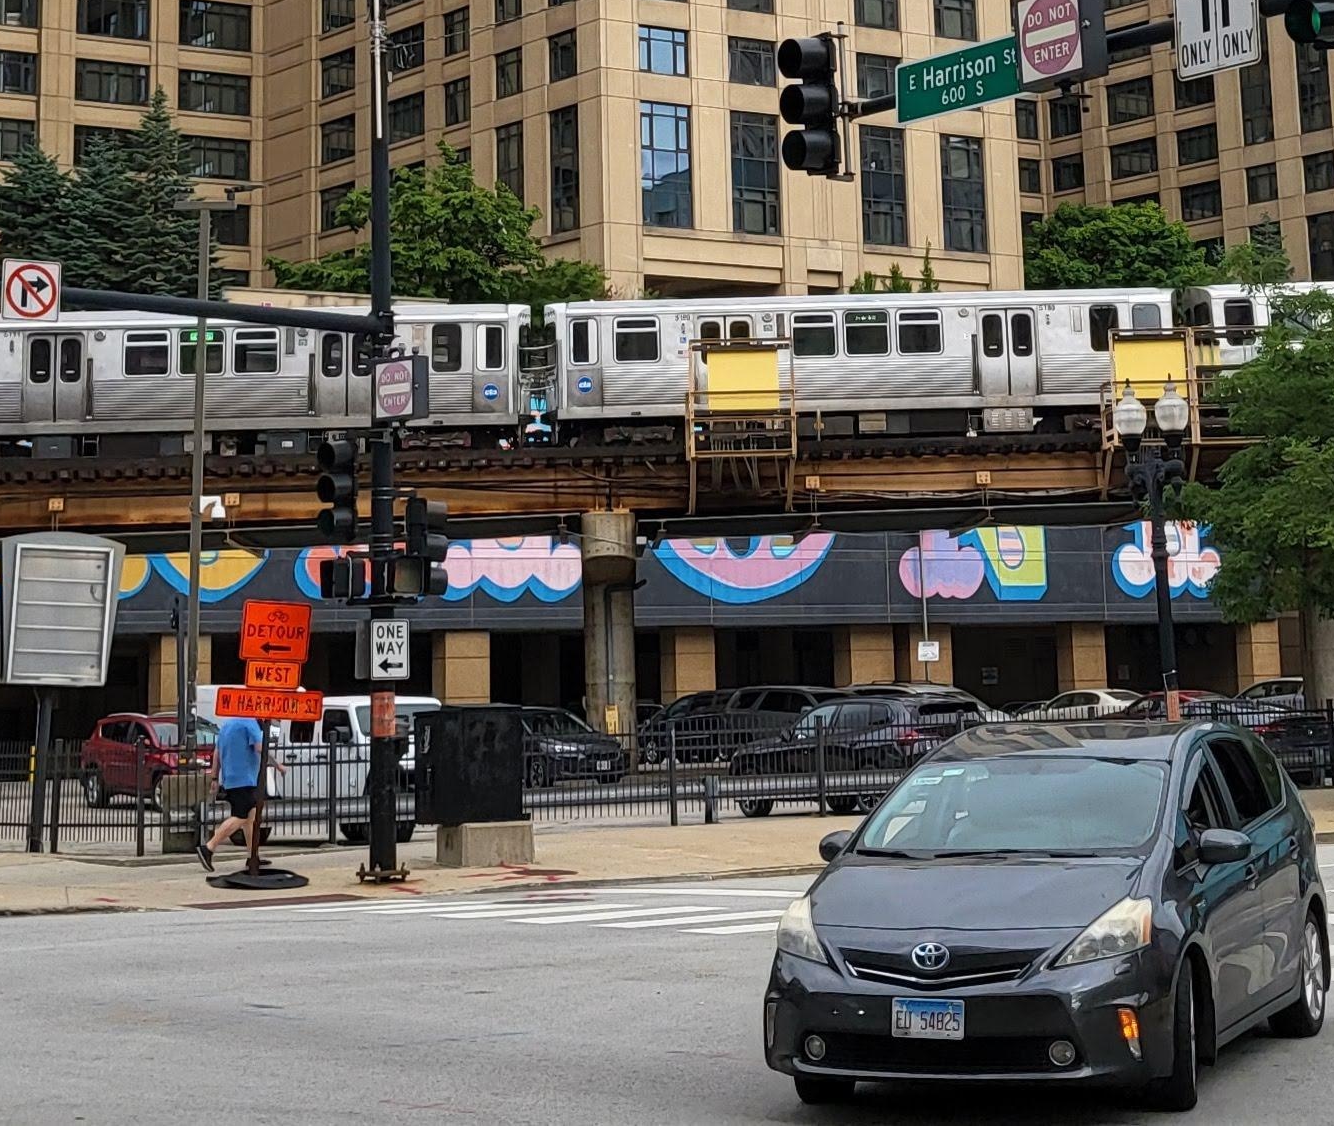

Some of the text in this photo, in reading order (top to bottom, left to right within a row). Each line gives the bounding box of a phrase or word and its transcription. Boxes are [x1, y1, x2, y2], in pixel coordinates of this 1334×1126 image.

[1027, 2, 1071, 28] DO NOT
[1033, 41, 1070, 65] ENTER
[1222, 27, 1255, 59] ONLY
[1181, 38, 1212, 69] ONLY
[909, 47, 1016, 91] E Harrison St
[941, 80, 984, 105] 600 S
[381, 370, 408, 383] DO NOT
[383, 394, 407, 407] ENTER
[247, 623, 305, 640] DETOUR
[376, 625, 404, 639] ONE
[376, 641, 404, 655] WAY
[255, 665, 291, 684] WEST
[222, 694, 320, 715] W HARRISON ST
[920, 1011, 960, 1031] 54825
